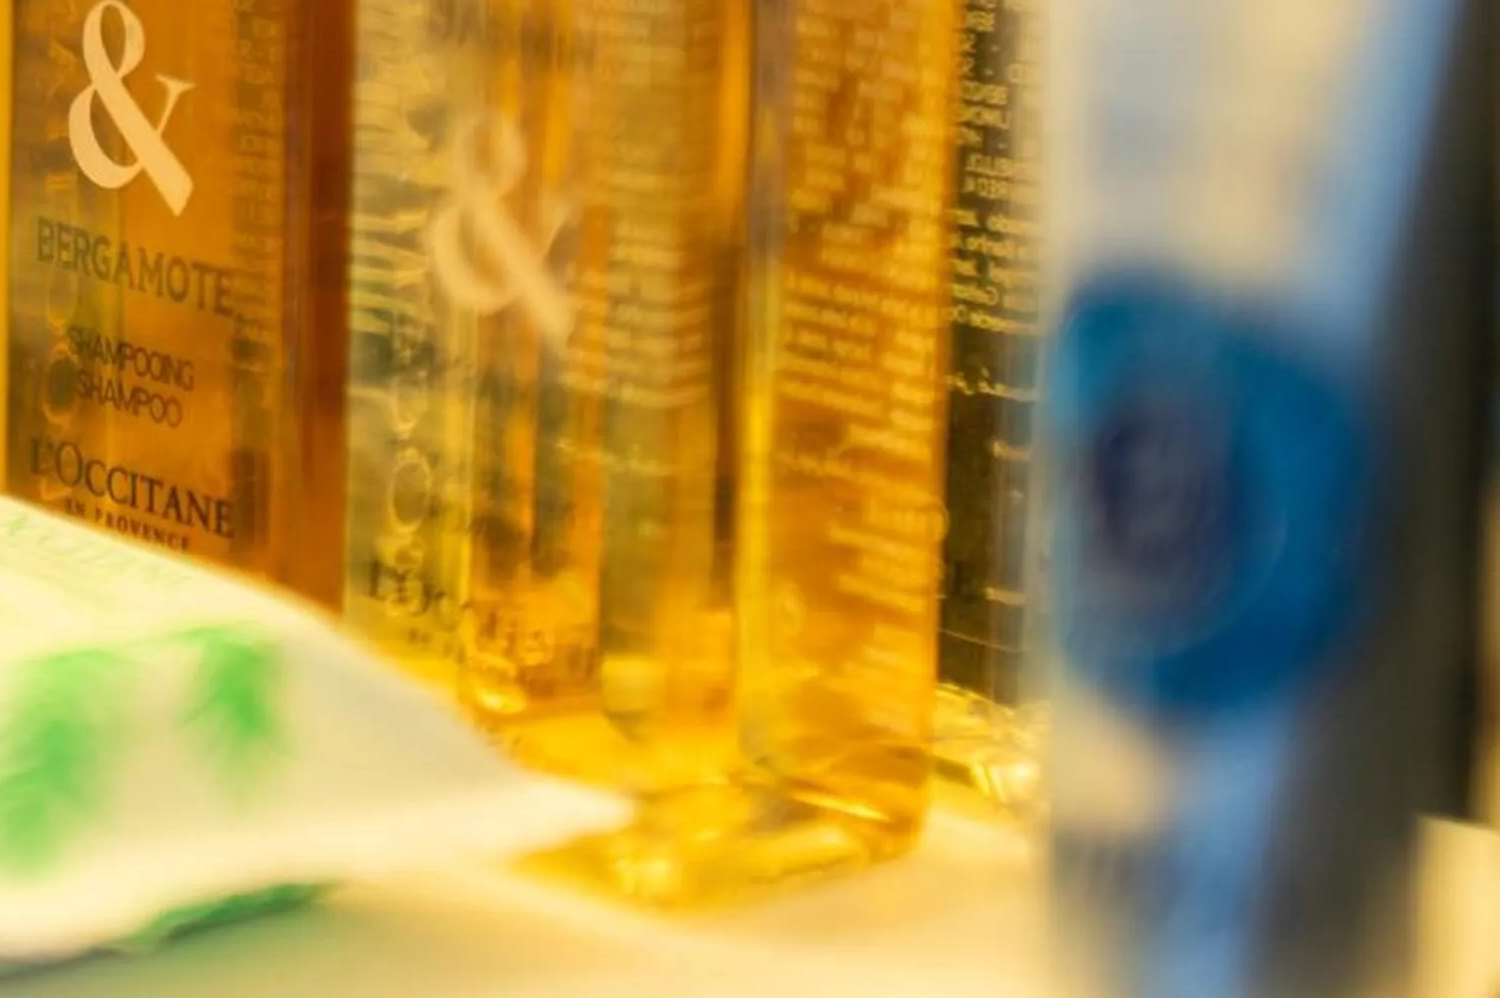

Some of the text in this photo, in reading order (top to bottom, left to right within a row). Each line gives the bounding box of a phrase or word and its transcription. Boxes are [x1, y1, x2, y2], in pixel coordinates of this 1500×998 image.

[36, 214, 236, 318] BERGAMOTE
[67, 325, 195, 392] SHAMPOOING
[75, 368, 183, 430] SHAMPOO
[29, 436, 235, 538] L'OCCITANE
[64, 497, 87, 518] EN
